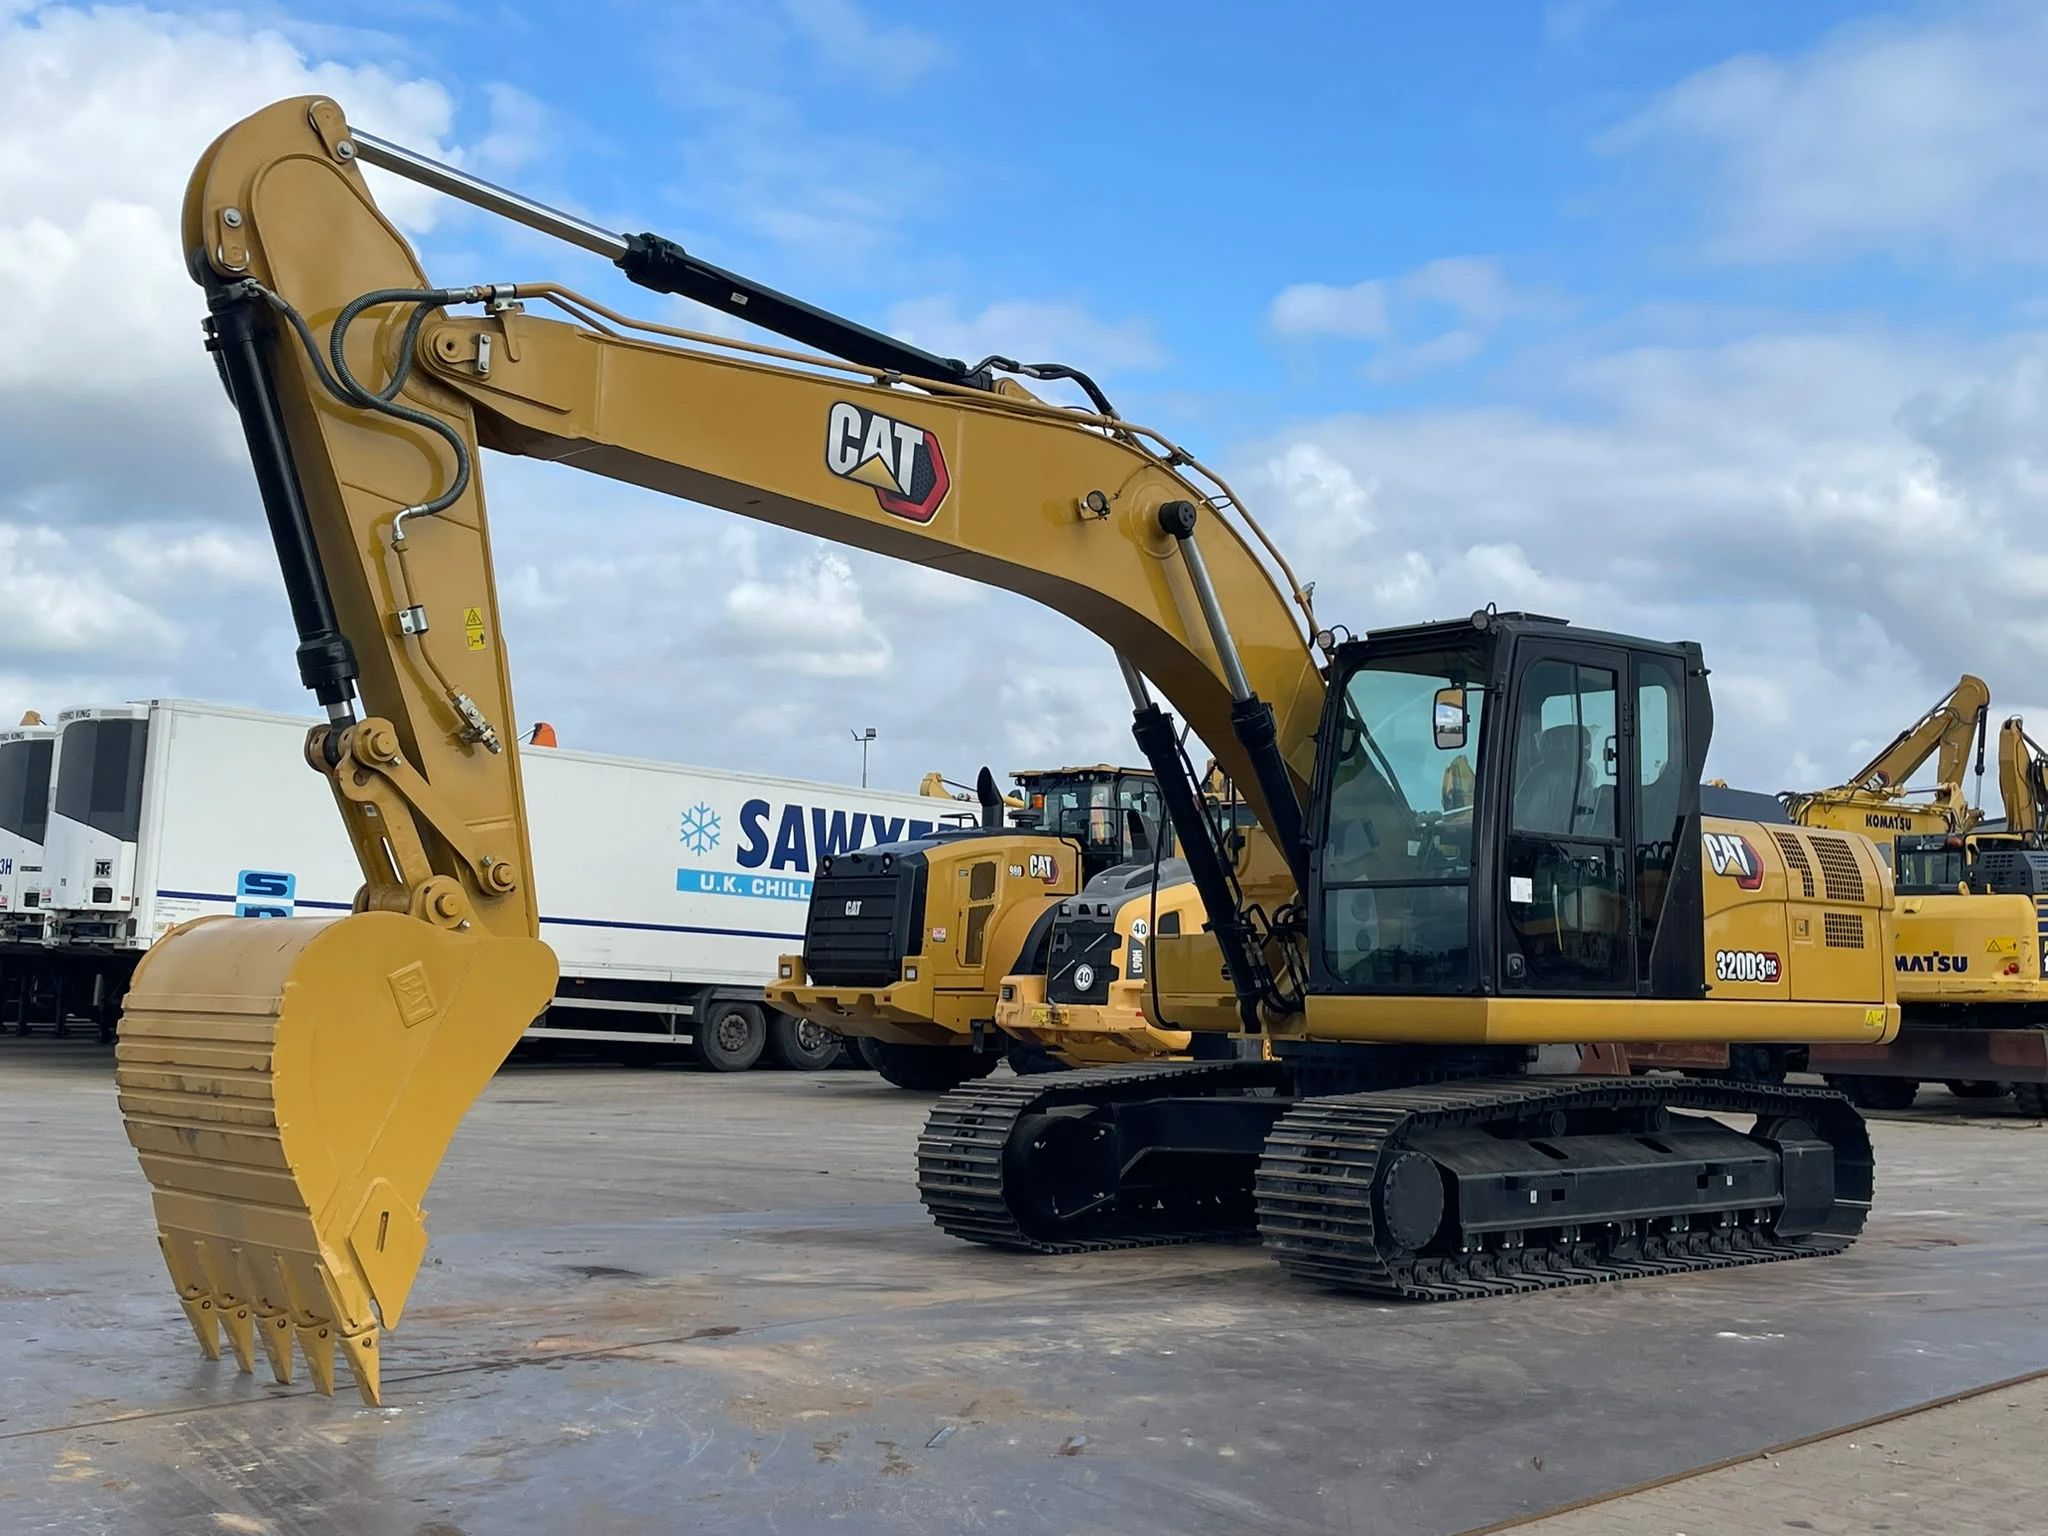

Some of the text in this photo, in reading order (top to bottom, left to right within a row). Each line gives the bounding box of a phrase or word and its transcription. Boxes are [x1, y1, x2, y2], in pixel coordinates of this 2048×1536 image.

[828, 403, 924, 496] CAT
[1866, 813, 1911, 831] KOMATSU
[736, 799, 959, 873] SAWY
[1029, 854, 1052, 878] CAT
[1703, 833, 1750, 876] CAT
[700, 874, 742, 893] U.K.
[845, 900, 862, 916] CAT
[1133, 922, 1147, 935] 40
[1132, 949, 1143, 973] L90H
[1716, 951, 1766, 981] 320D3
[1077, 971, 1091, 983] 40
